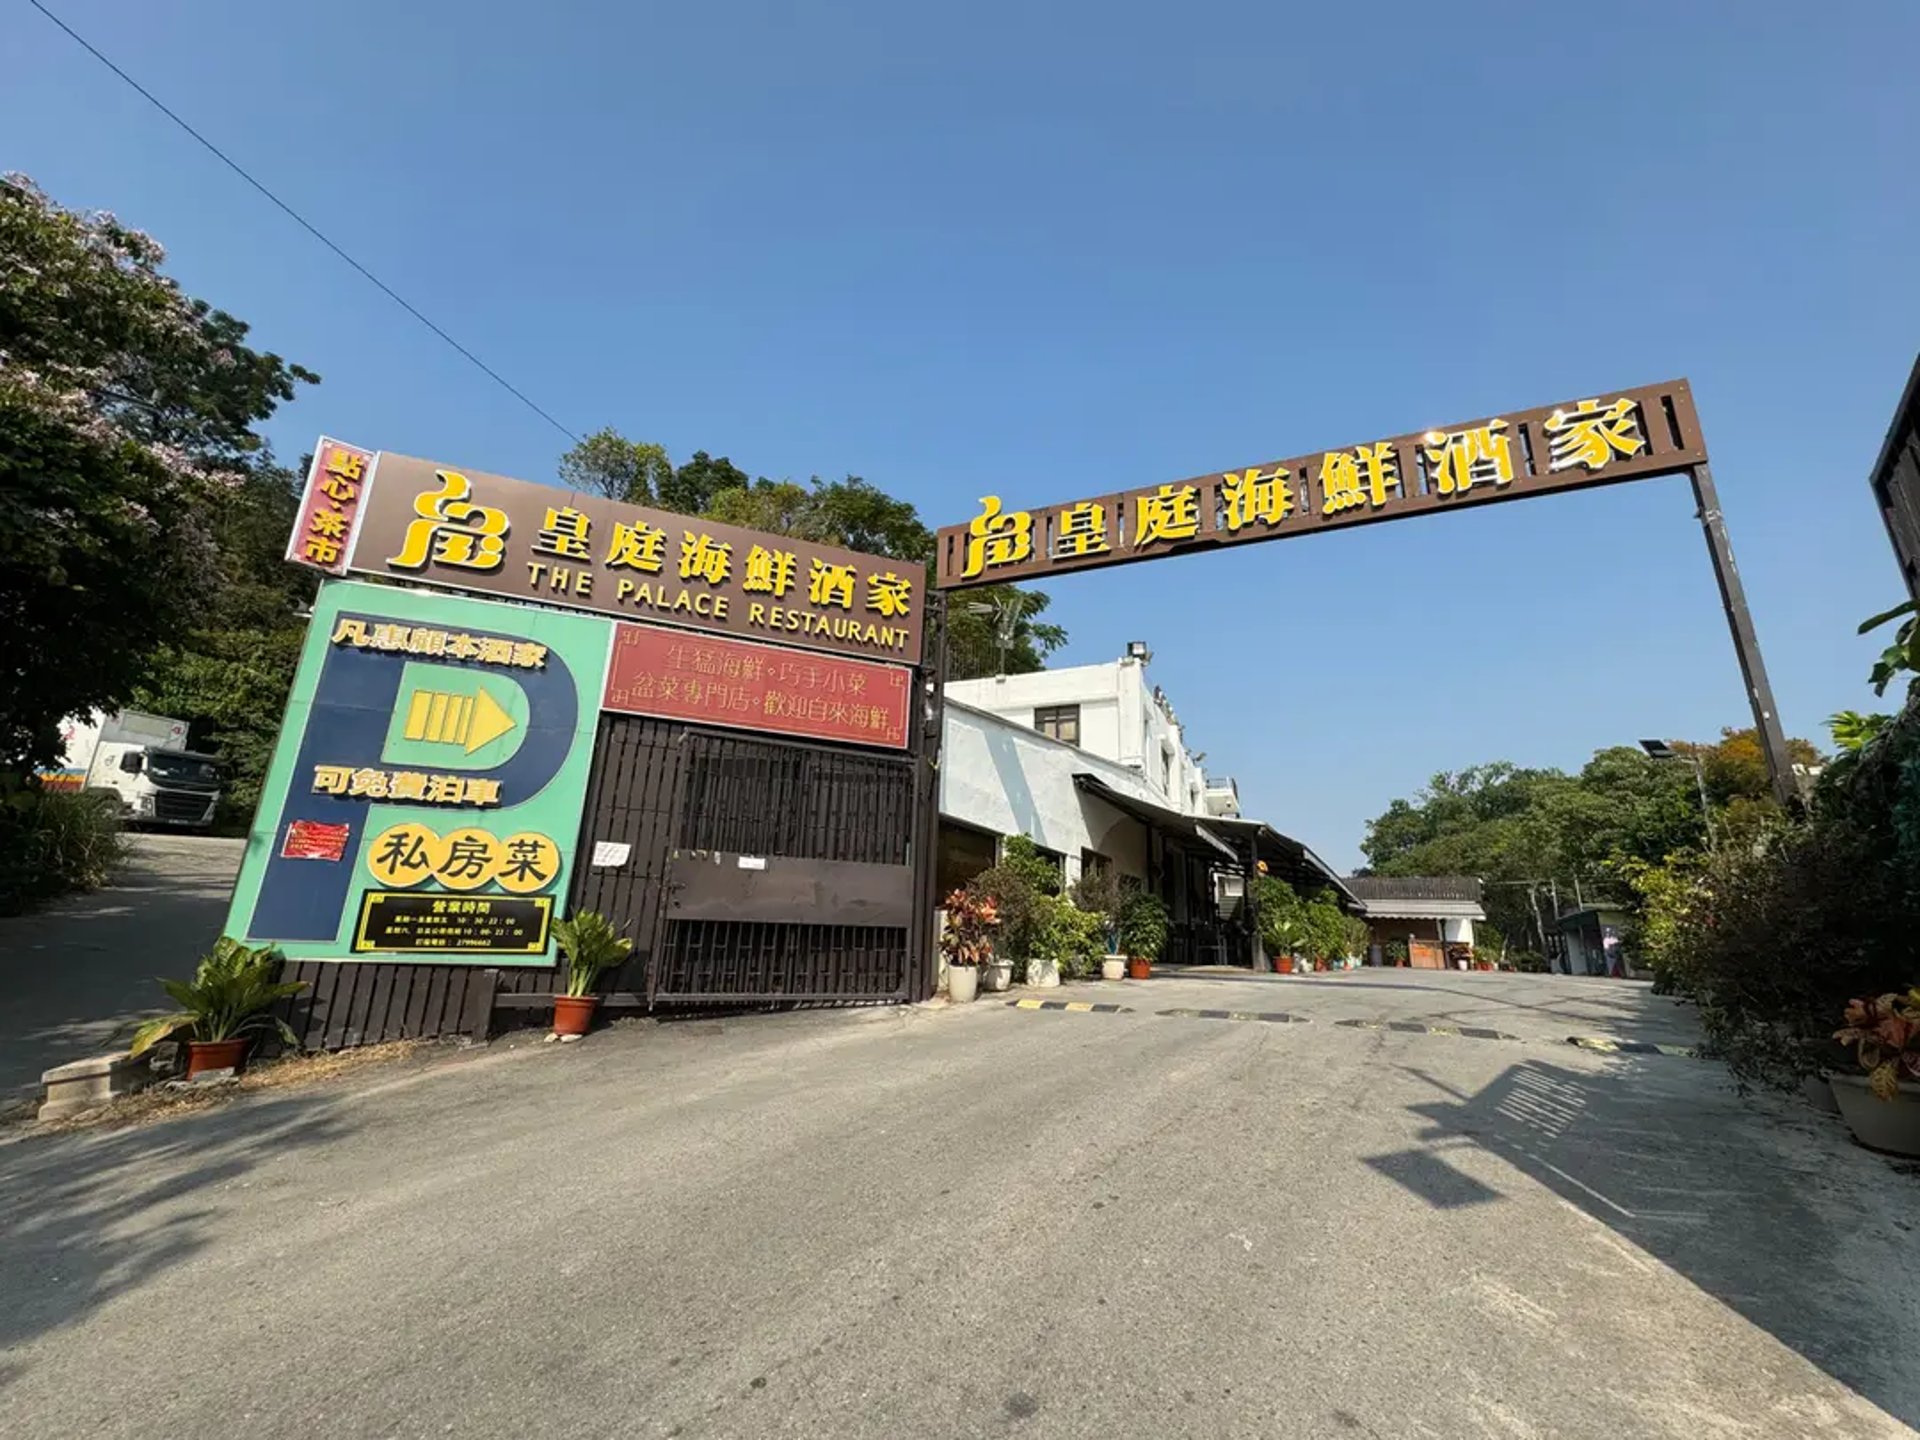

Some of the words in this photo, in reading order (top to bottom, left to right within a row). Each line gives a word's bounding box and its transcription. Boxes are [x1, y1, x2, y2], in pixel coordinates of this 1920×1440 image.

[1052, 397, 1646, 561] 皇庭海鮮酒家
[526, 561, 593, 595] THE
[616, 578, 730, 619] PALACE
[749, 602, 910, 650] RESTAURANT
[530, 506, 913, 618] 皇庭海鮮酒家
[313, 765, 502, 805] 可免費泊車
[376, 832, 548, 882] 私房菜
